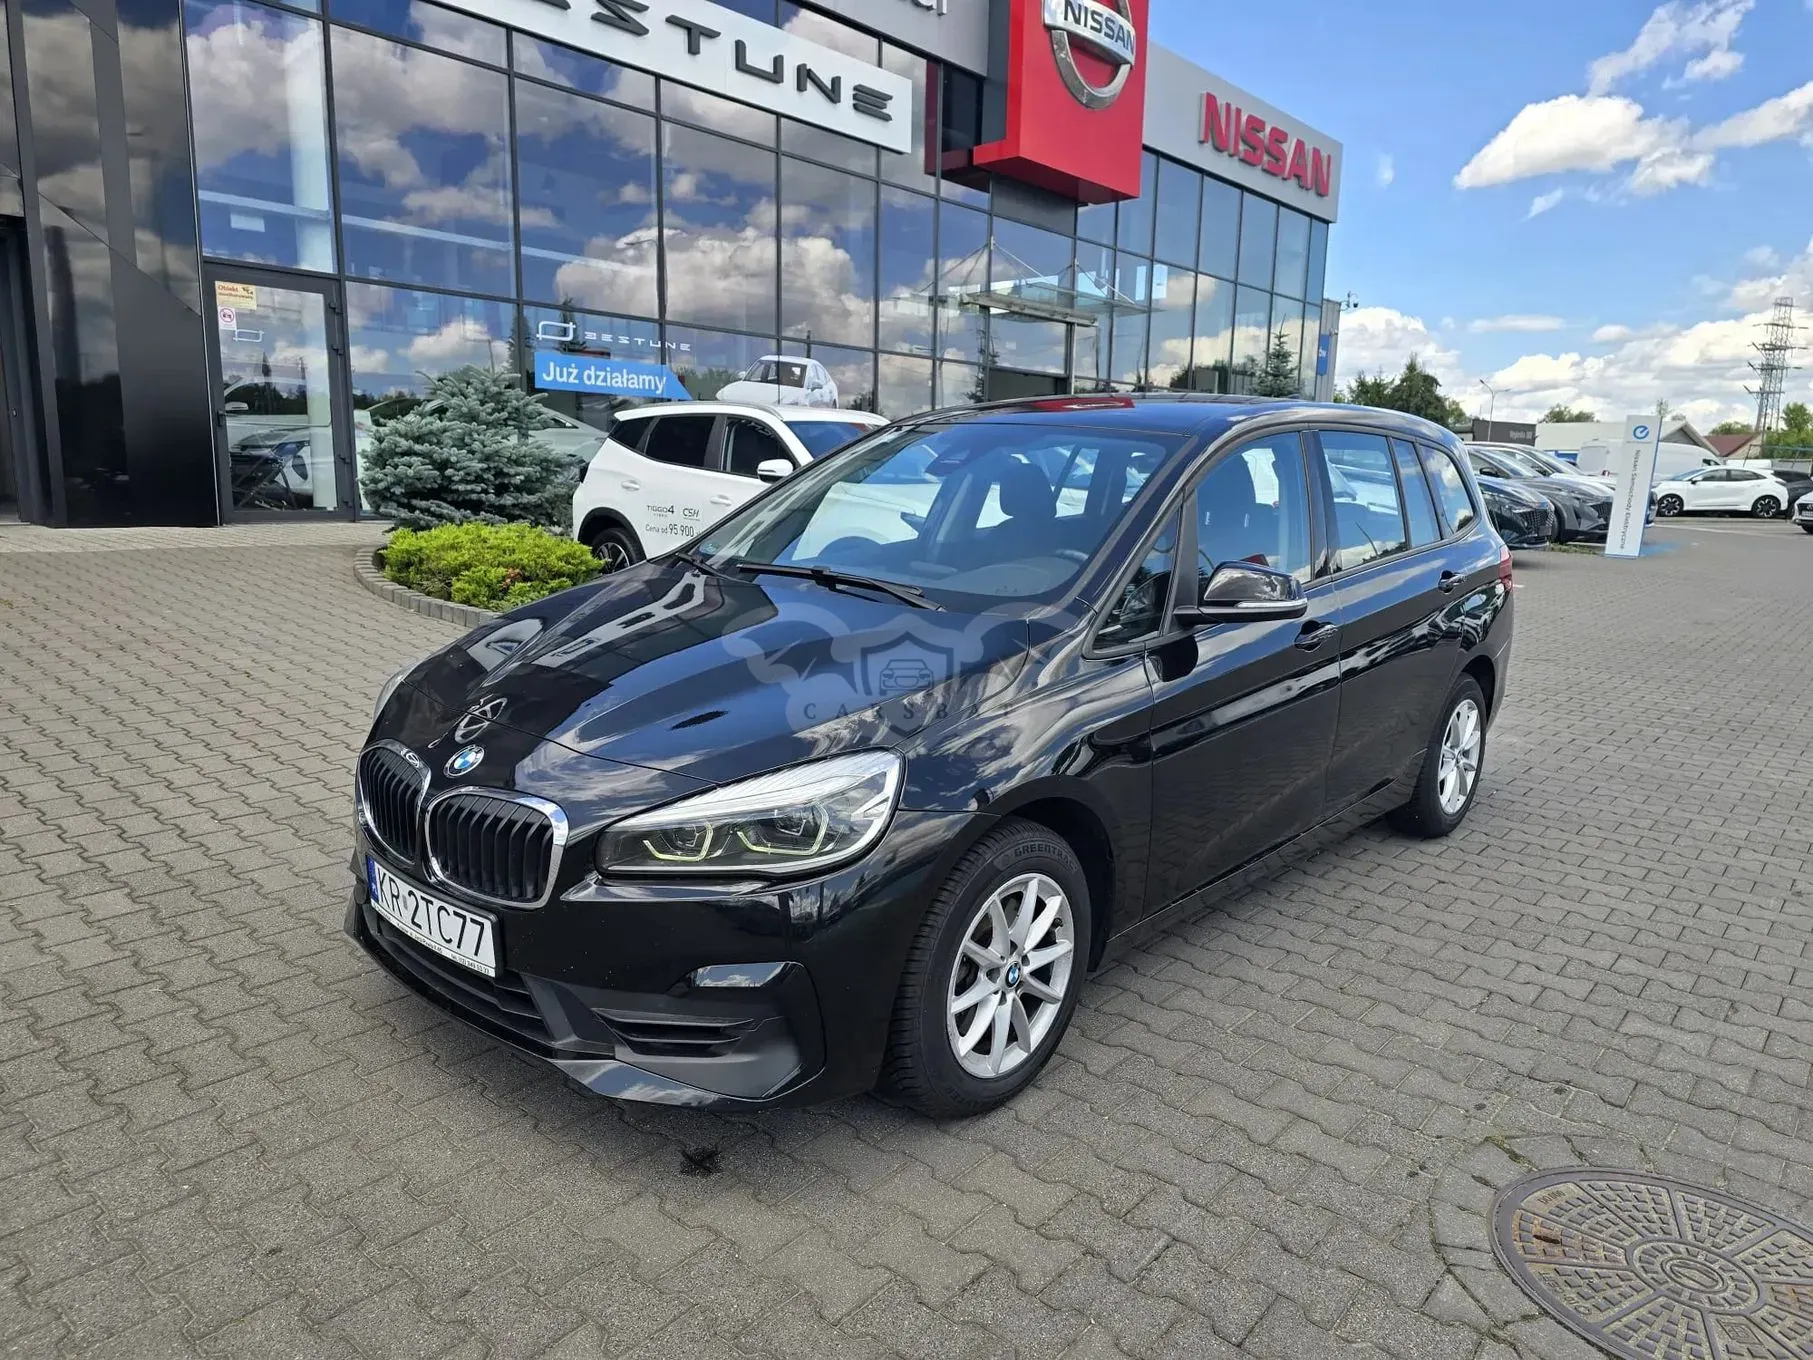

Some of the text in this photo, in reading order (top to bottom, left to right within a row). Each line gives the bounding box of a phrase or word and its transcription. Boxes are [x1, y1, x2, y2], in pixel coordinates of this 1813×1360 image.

[1064, 0, 1135, 56] NISSAN
[1202, 91, 1332, 197] NISSAN
[584, 331, 691, 352] BESTUNE
[542, 361, 667, 395] Już działamy
[1631, 449, 1642, 472] Nissan
[669, 523, 679, 535] 95
[680, 524, 695, 538] 900
[378, 868, 402, 916] KR
[407, 890, 485, 956] 2TC77
